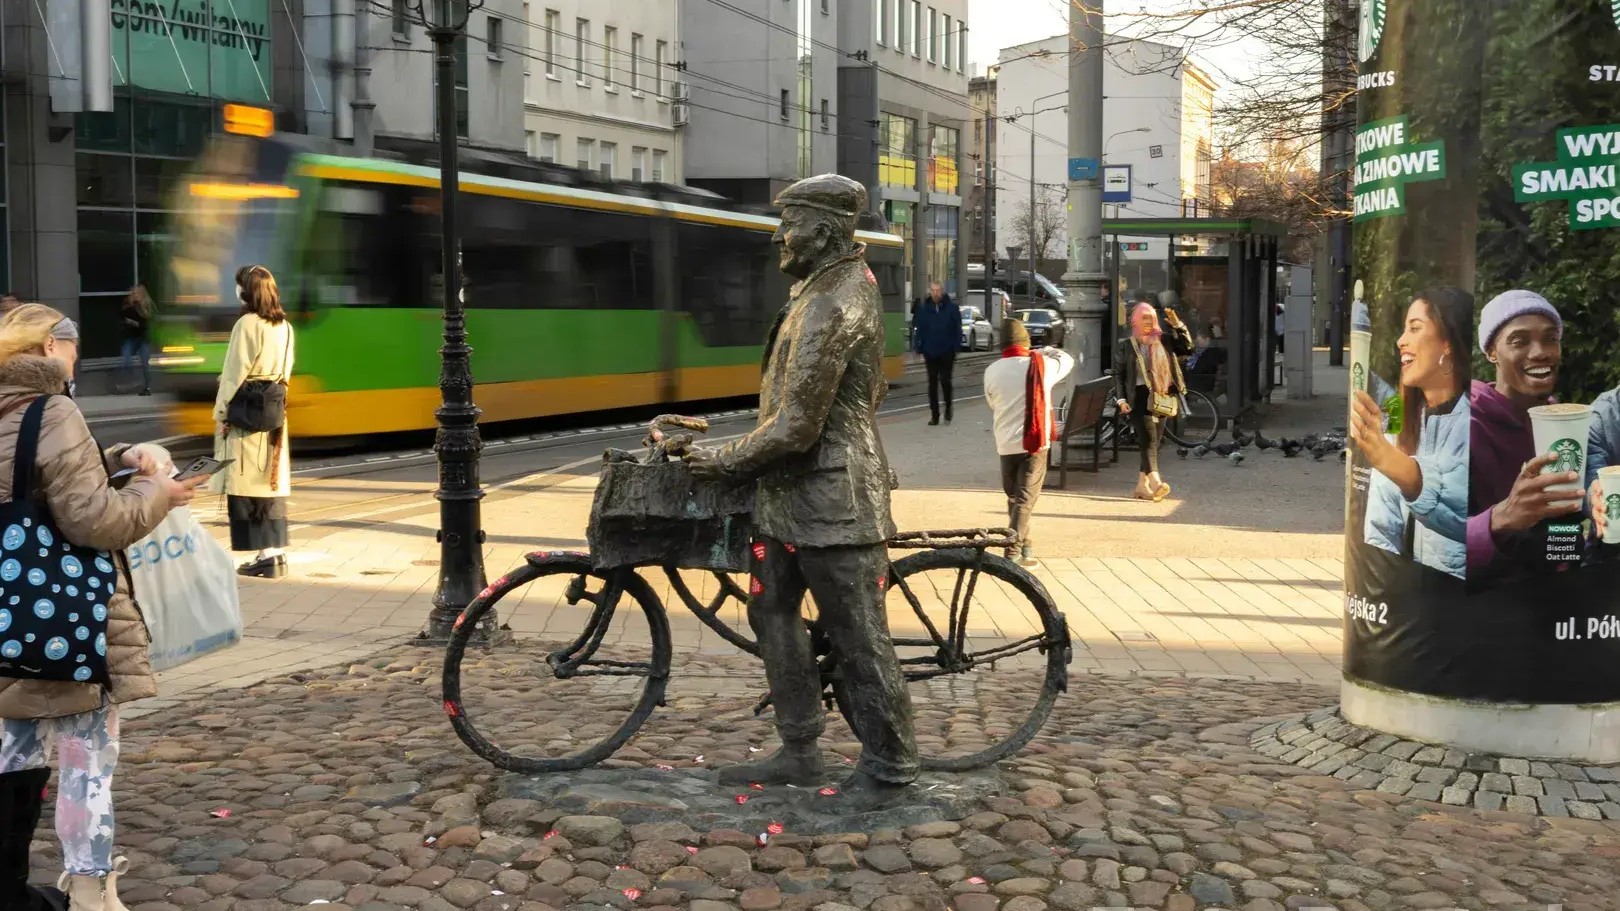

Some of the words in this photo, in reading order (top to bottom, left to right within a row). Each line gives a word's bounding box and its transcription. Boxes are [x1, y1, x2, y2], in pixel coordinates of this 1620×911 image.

[1363, 149, 1440, 183] ZIMOWE
[1521, 164, 1616, 194] SMAKI
[1546, 544, 1575, 552] Biscotti
[1378, 602, 1388, 625] 2
[1555, 616, 1582, 640] ul.
